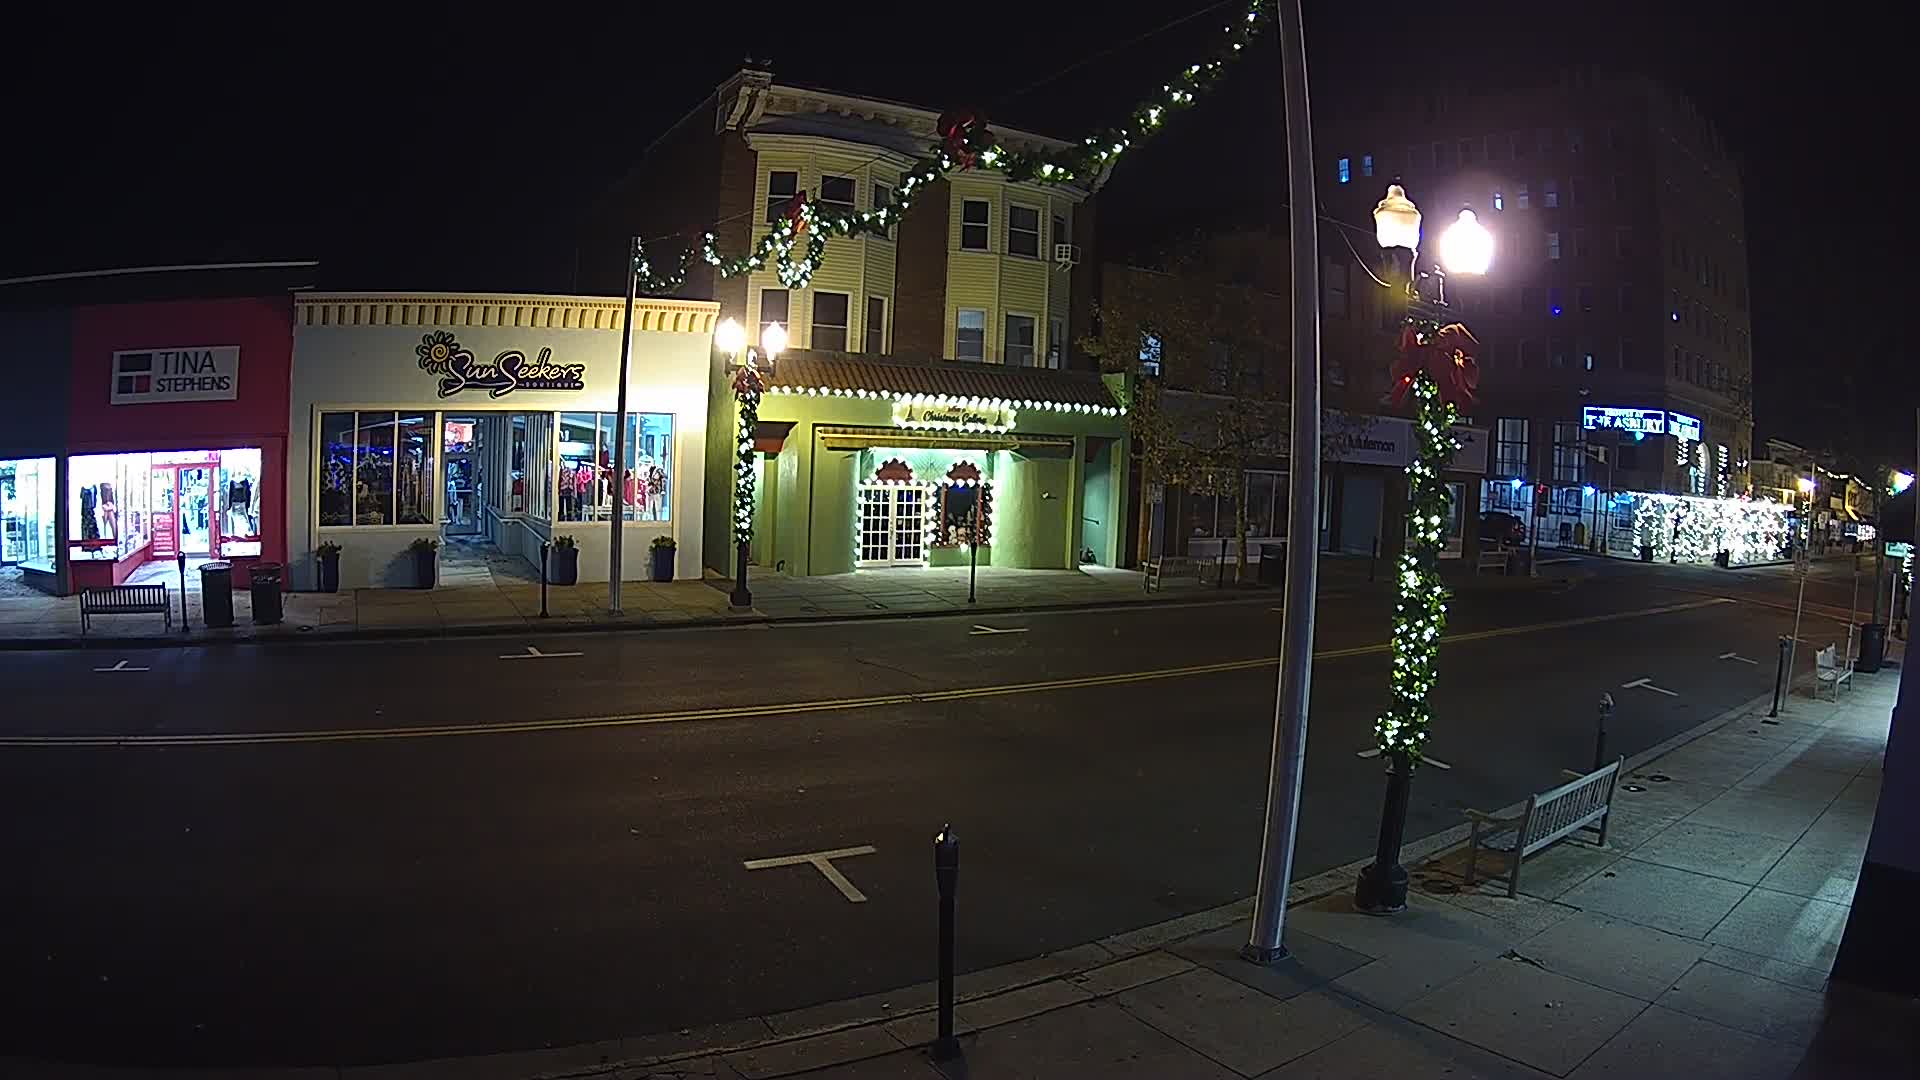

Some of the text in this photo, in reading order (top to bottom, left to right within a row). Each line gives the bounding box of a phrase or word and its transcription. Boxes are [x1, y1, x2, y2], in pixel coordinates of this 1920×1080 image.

[160, 350, 217, 375] TINA
[445, 348, 584, 395] Sun Seekers
[156, 375, 231, 393] STEPHENS
